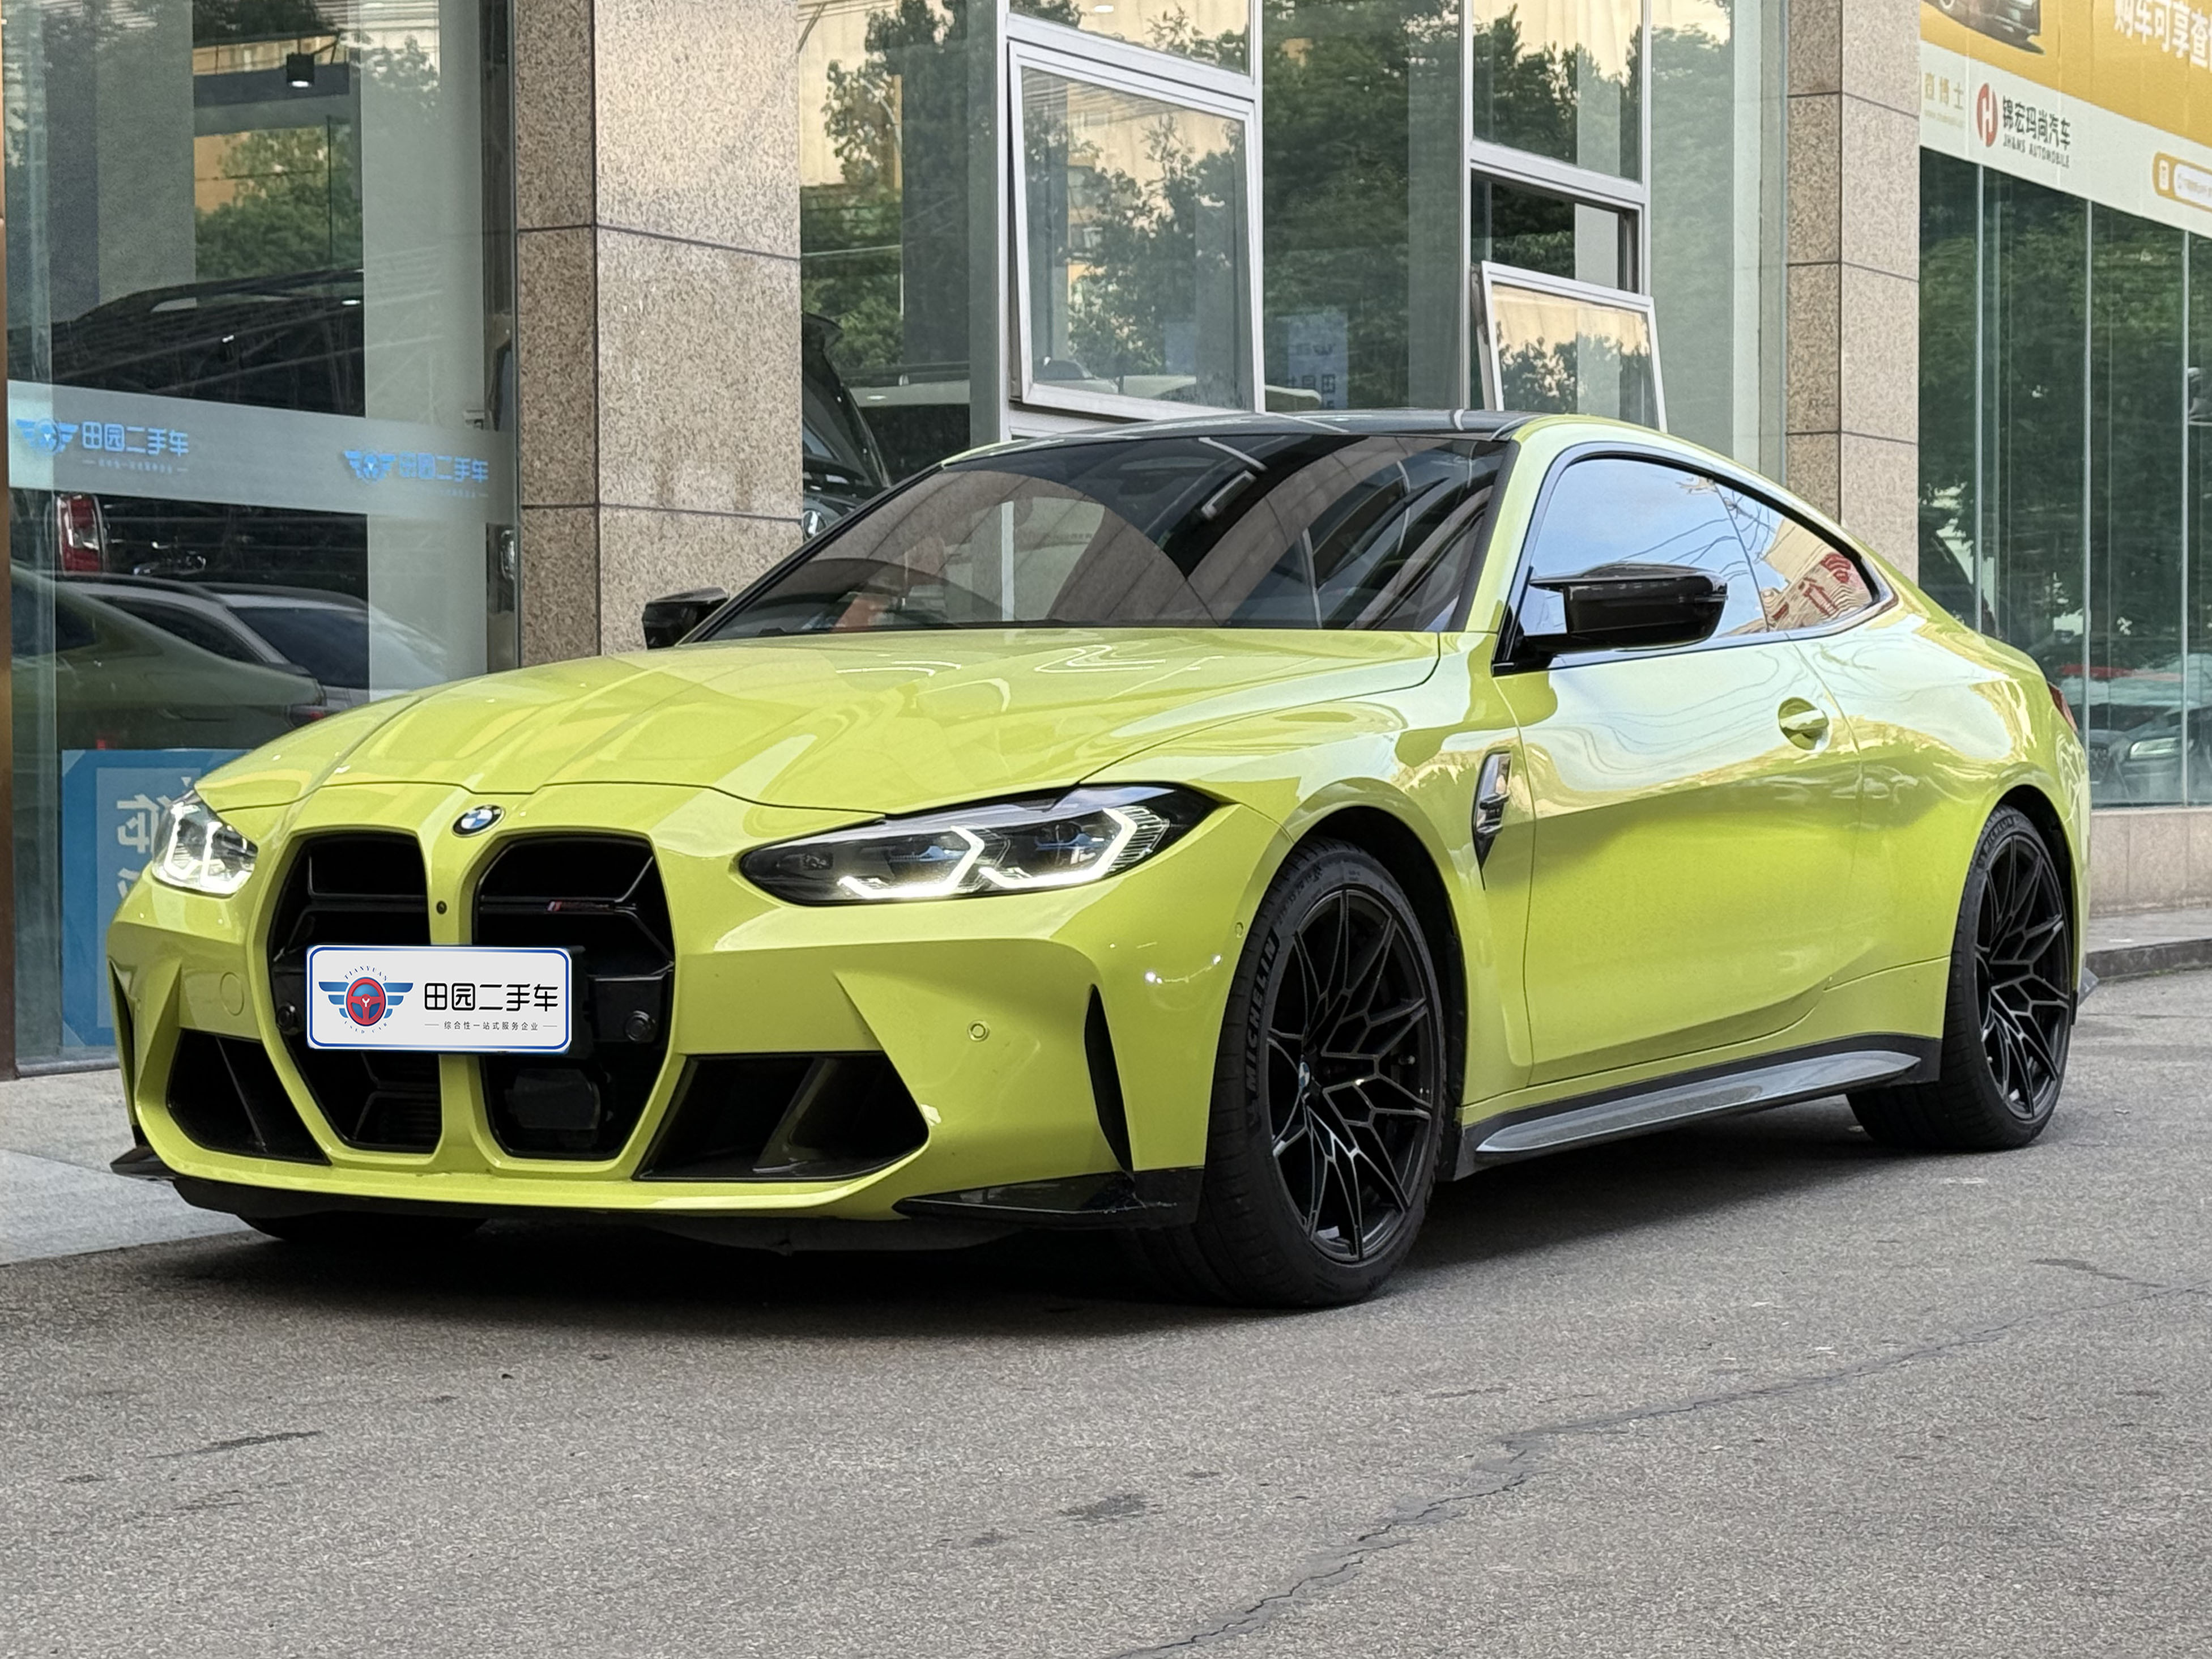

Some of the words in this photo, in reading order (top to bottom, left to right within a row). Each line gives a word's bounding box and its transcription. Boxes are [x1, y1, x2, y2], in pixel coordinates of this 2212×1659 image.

[2114, 0, 2212, 73] 购车可享查
[82, 421, 189, 457] 田园二手车
[398, 452, 489, 483] 田园二手车
[424, 982, 559, 1012] 田园二手车
[444, 1020, 539, 1031] 综合性一站式服务企业
[1246, 937, 1278, 1091] MICHELIN
